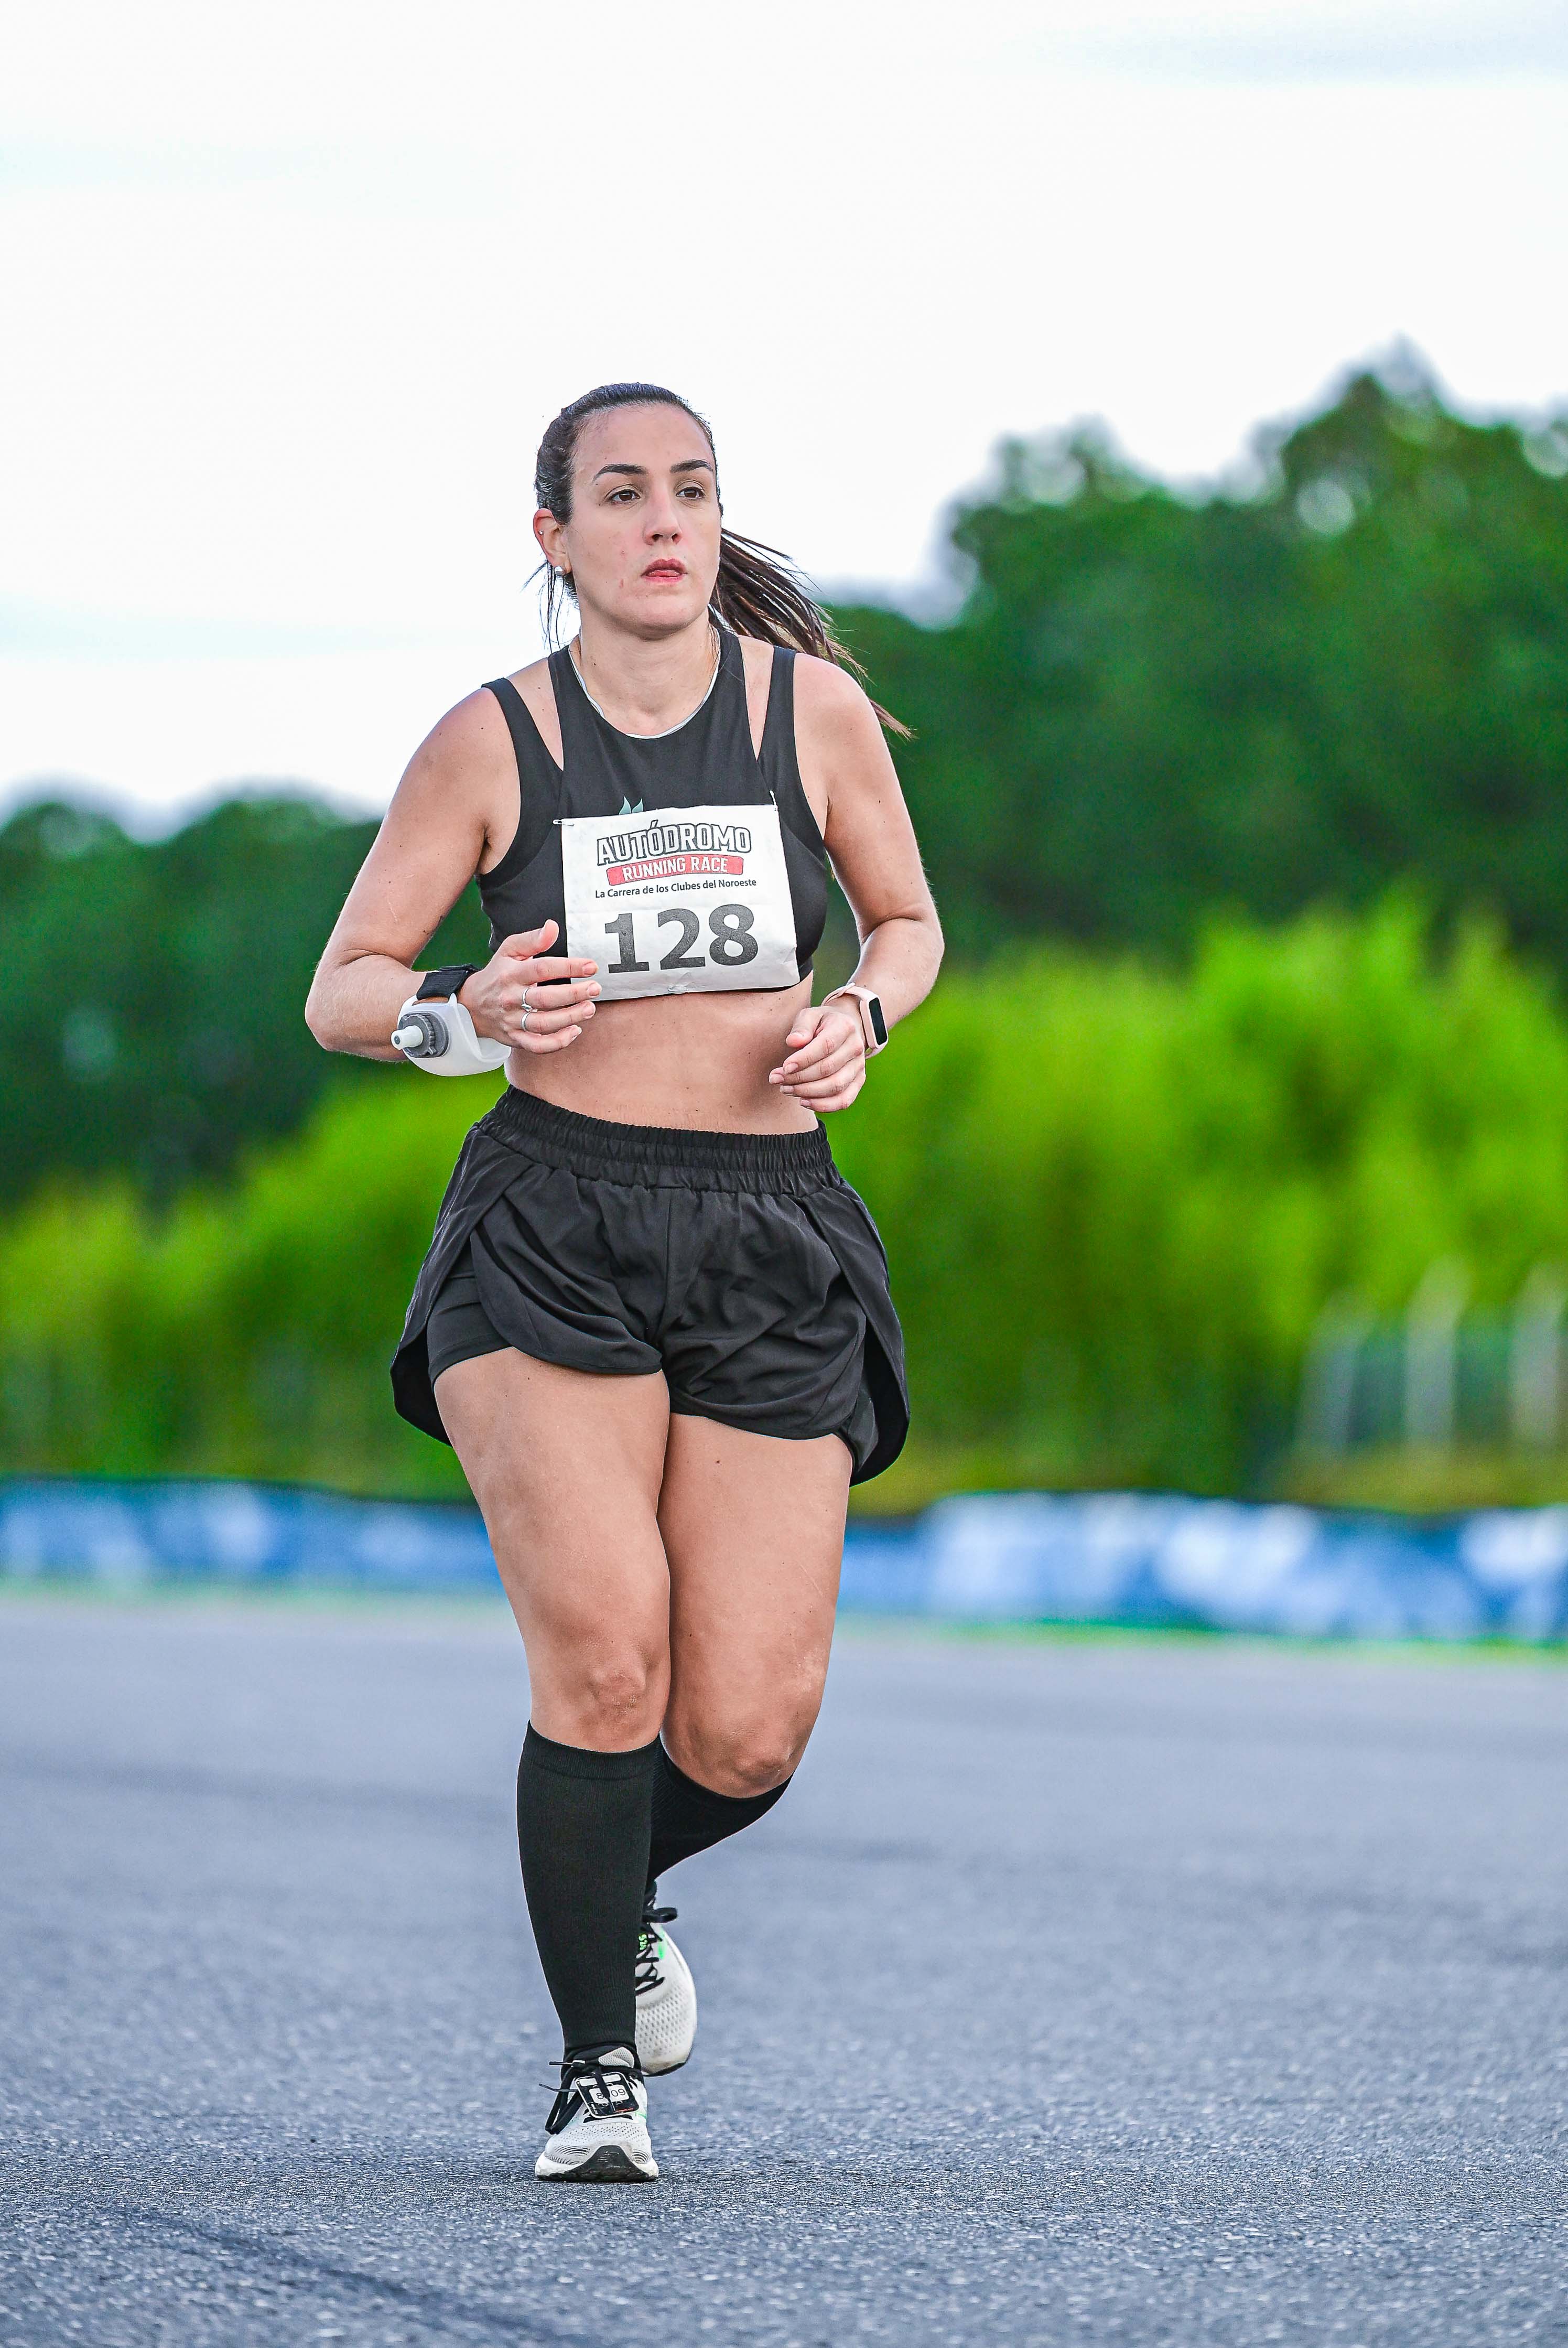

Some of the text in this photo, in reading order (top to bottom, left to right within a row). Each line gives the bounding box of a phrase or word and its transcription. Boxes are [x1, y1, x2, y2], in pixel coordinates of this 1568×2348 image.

[597, 820, 751, 866] AUTÓDROMO
[622, 857, 728, 881] RUNNING RACE
[595, 879, 757, 898] La Carrera de los Clubes del Noroeste
[604, 904, 758, 974] 128
[596, 2088, 625, 2099] 809
